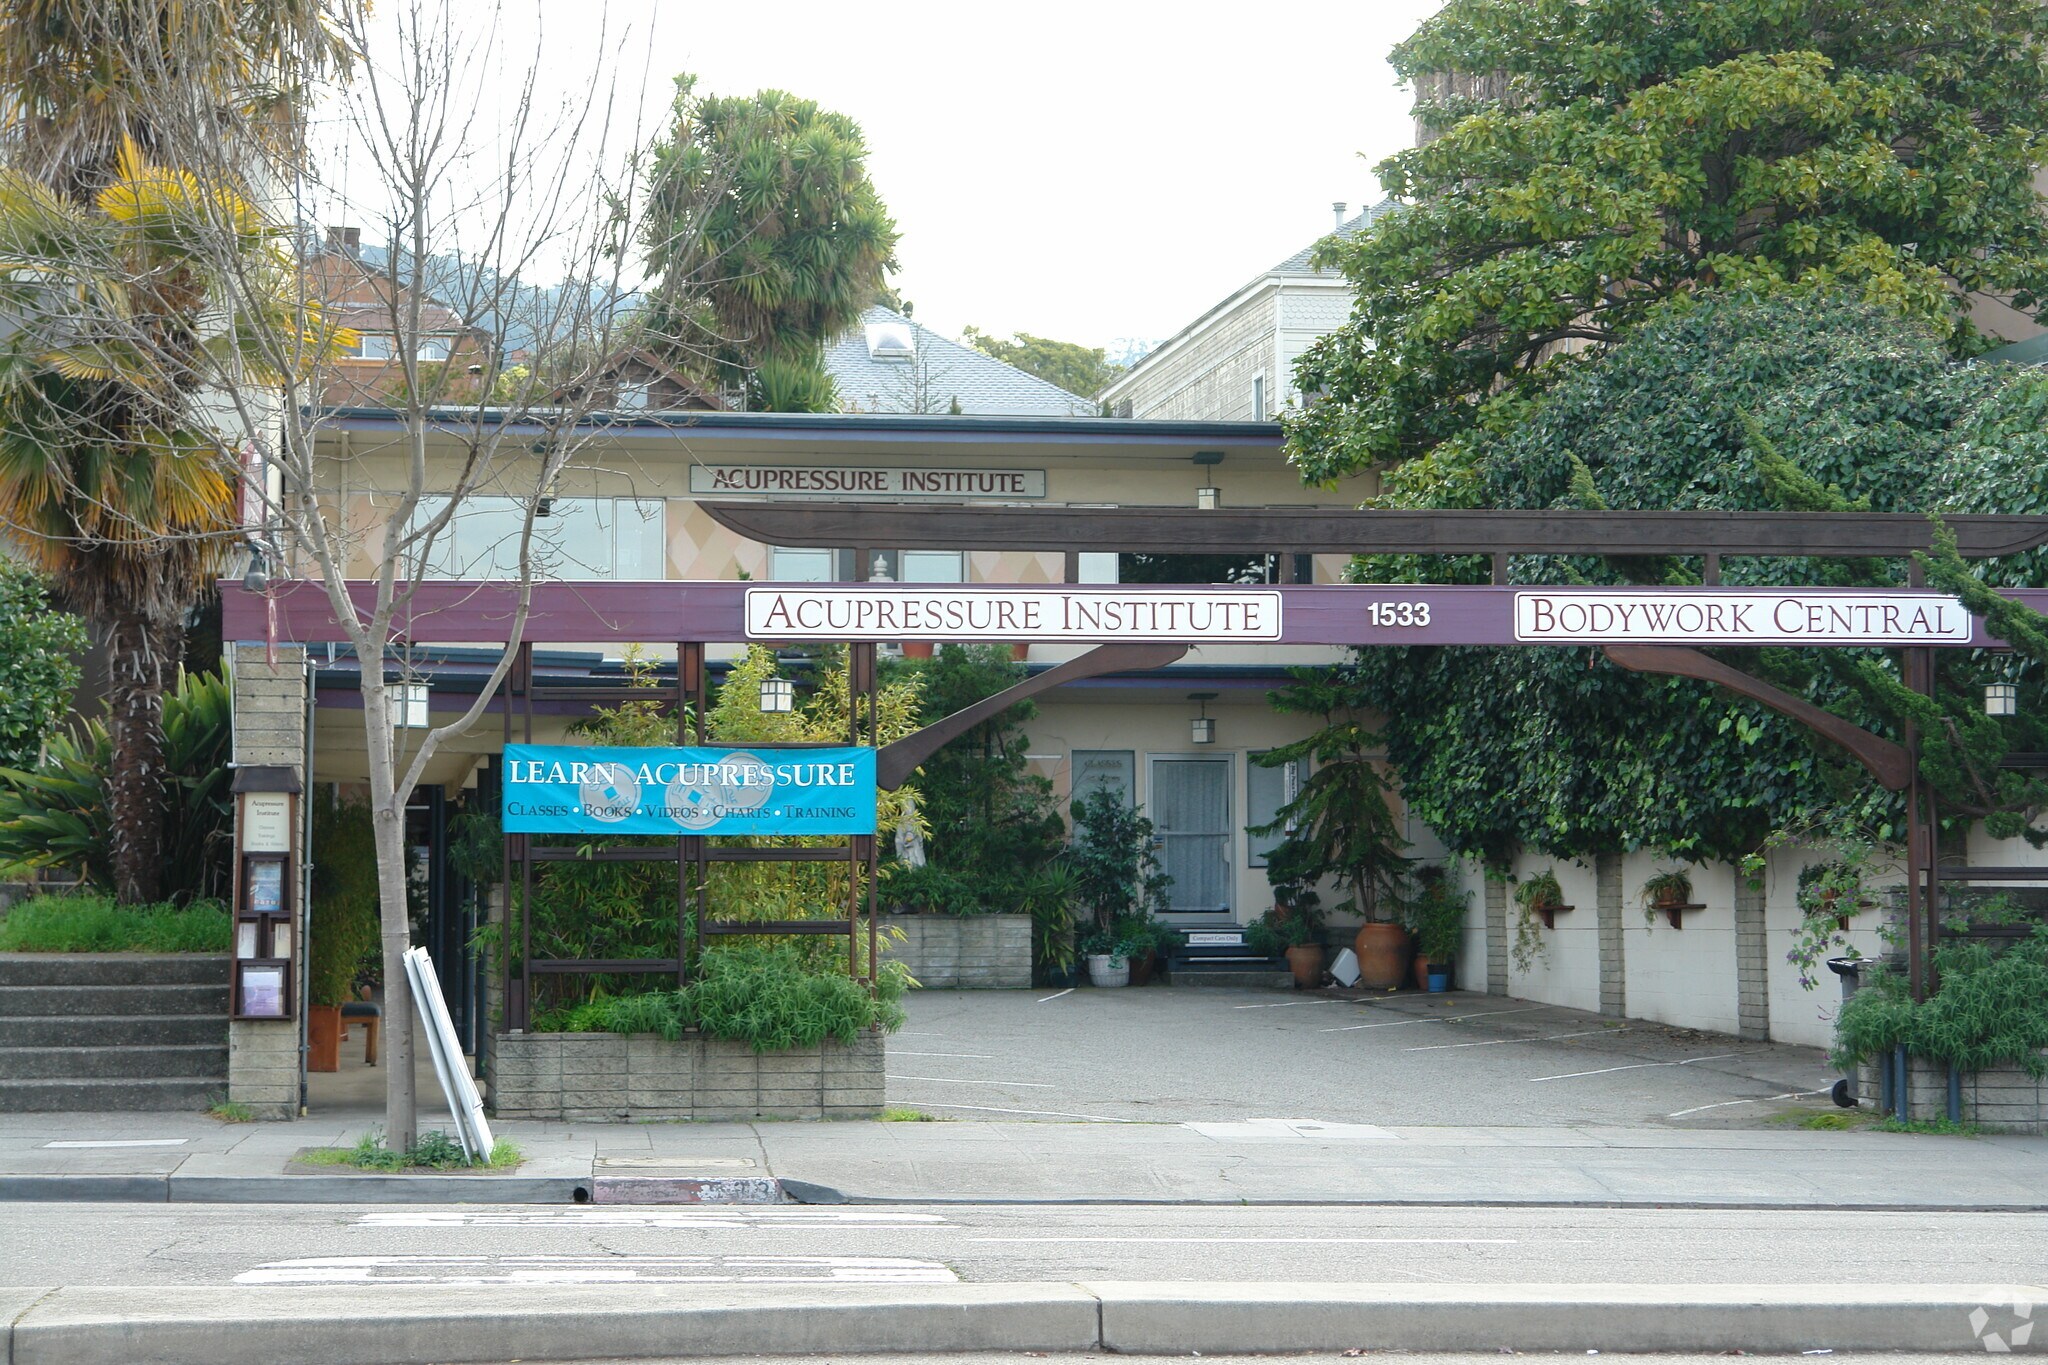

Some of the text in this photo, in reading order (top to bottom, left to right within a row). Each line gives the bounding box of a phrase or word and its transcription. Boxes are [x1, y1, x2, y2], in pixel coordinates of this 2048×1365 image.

[711, 468, 1026, 493] ACUPRESSURE INSTITUTE
[763, 593, 1262, 632] ACUPRESSURE INSTITUTE
[1367, 601, 1431, 627] 1533
[1531, 598, 1956, 637] BODYWORK CENTRAL
[509, 759, 856, 788] LEARN ACUPRESSURE
[507, 802, 857, 820] CLASSES BOOKS VIDEOS CHARTS TRAINING
